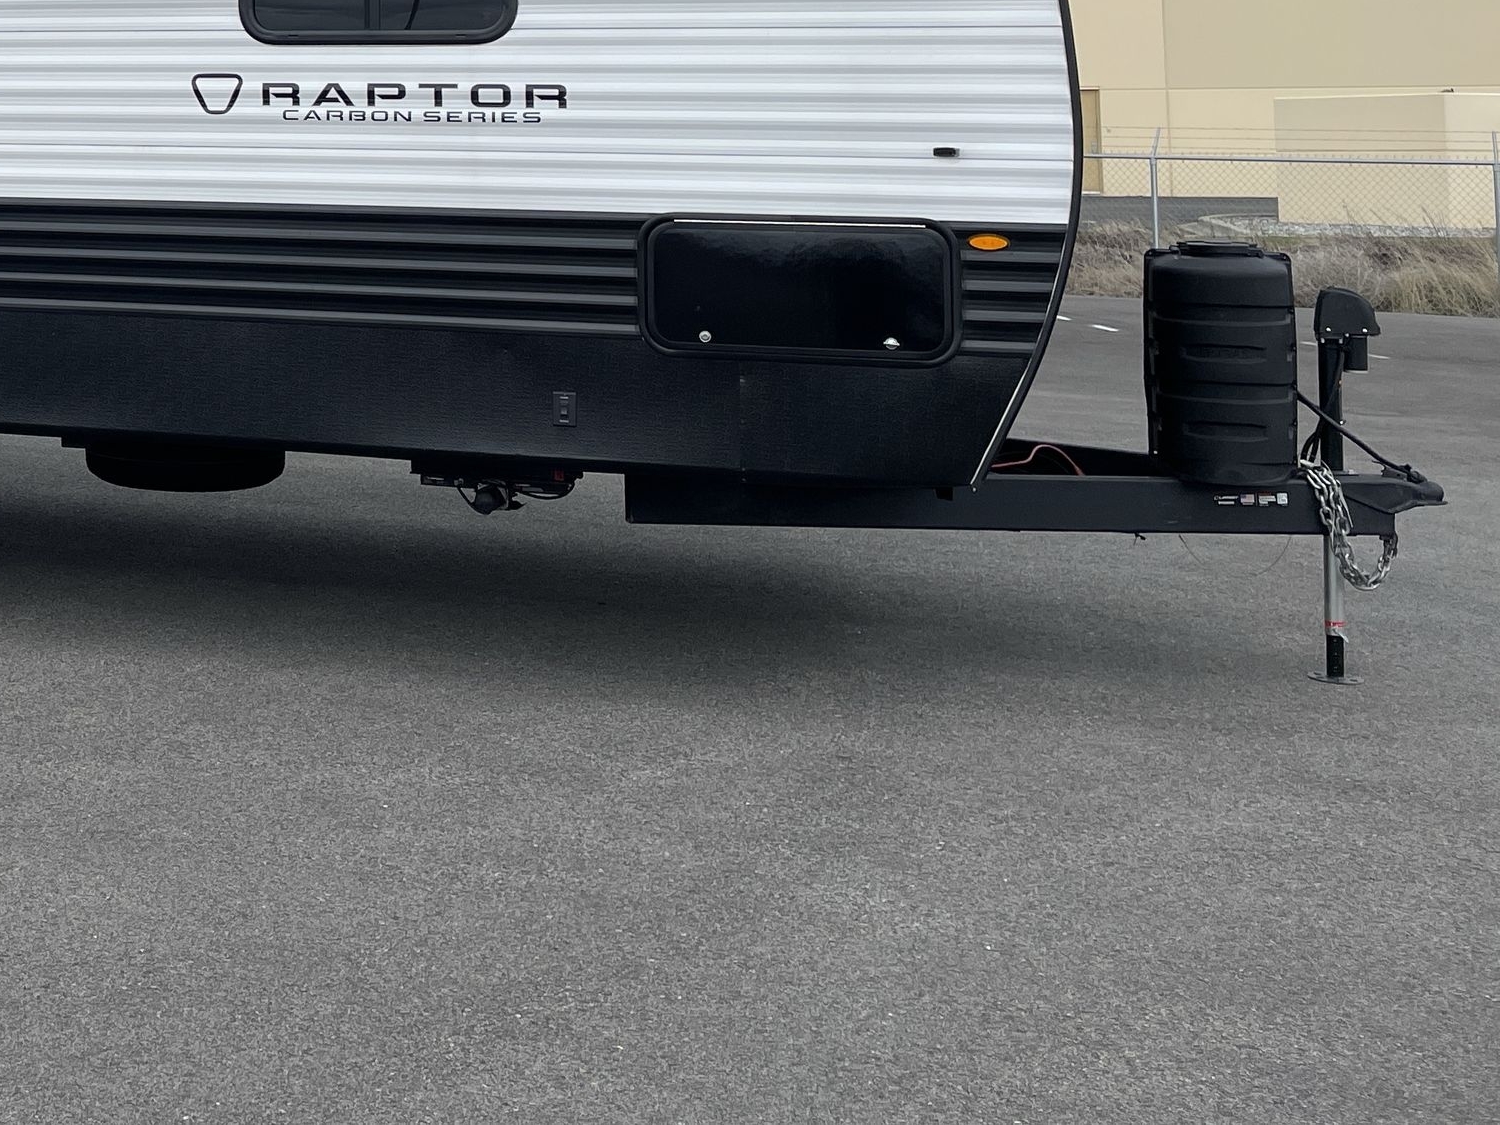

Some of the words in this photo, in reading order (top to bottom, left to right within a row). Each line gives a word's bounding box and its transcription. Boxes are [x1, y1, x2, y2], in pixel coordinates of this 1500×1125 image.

[262, 82, 568, 109] RAPTOR
[282, 109, 412, 122] CARBON
[423, 111, 542, 123] SERIES
